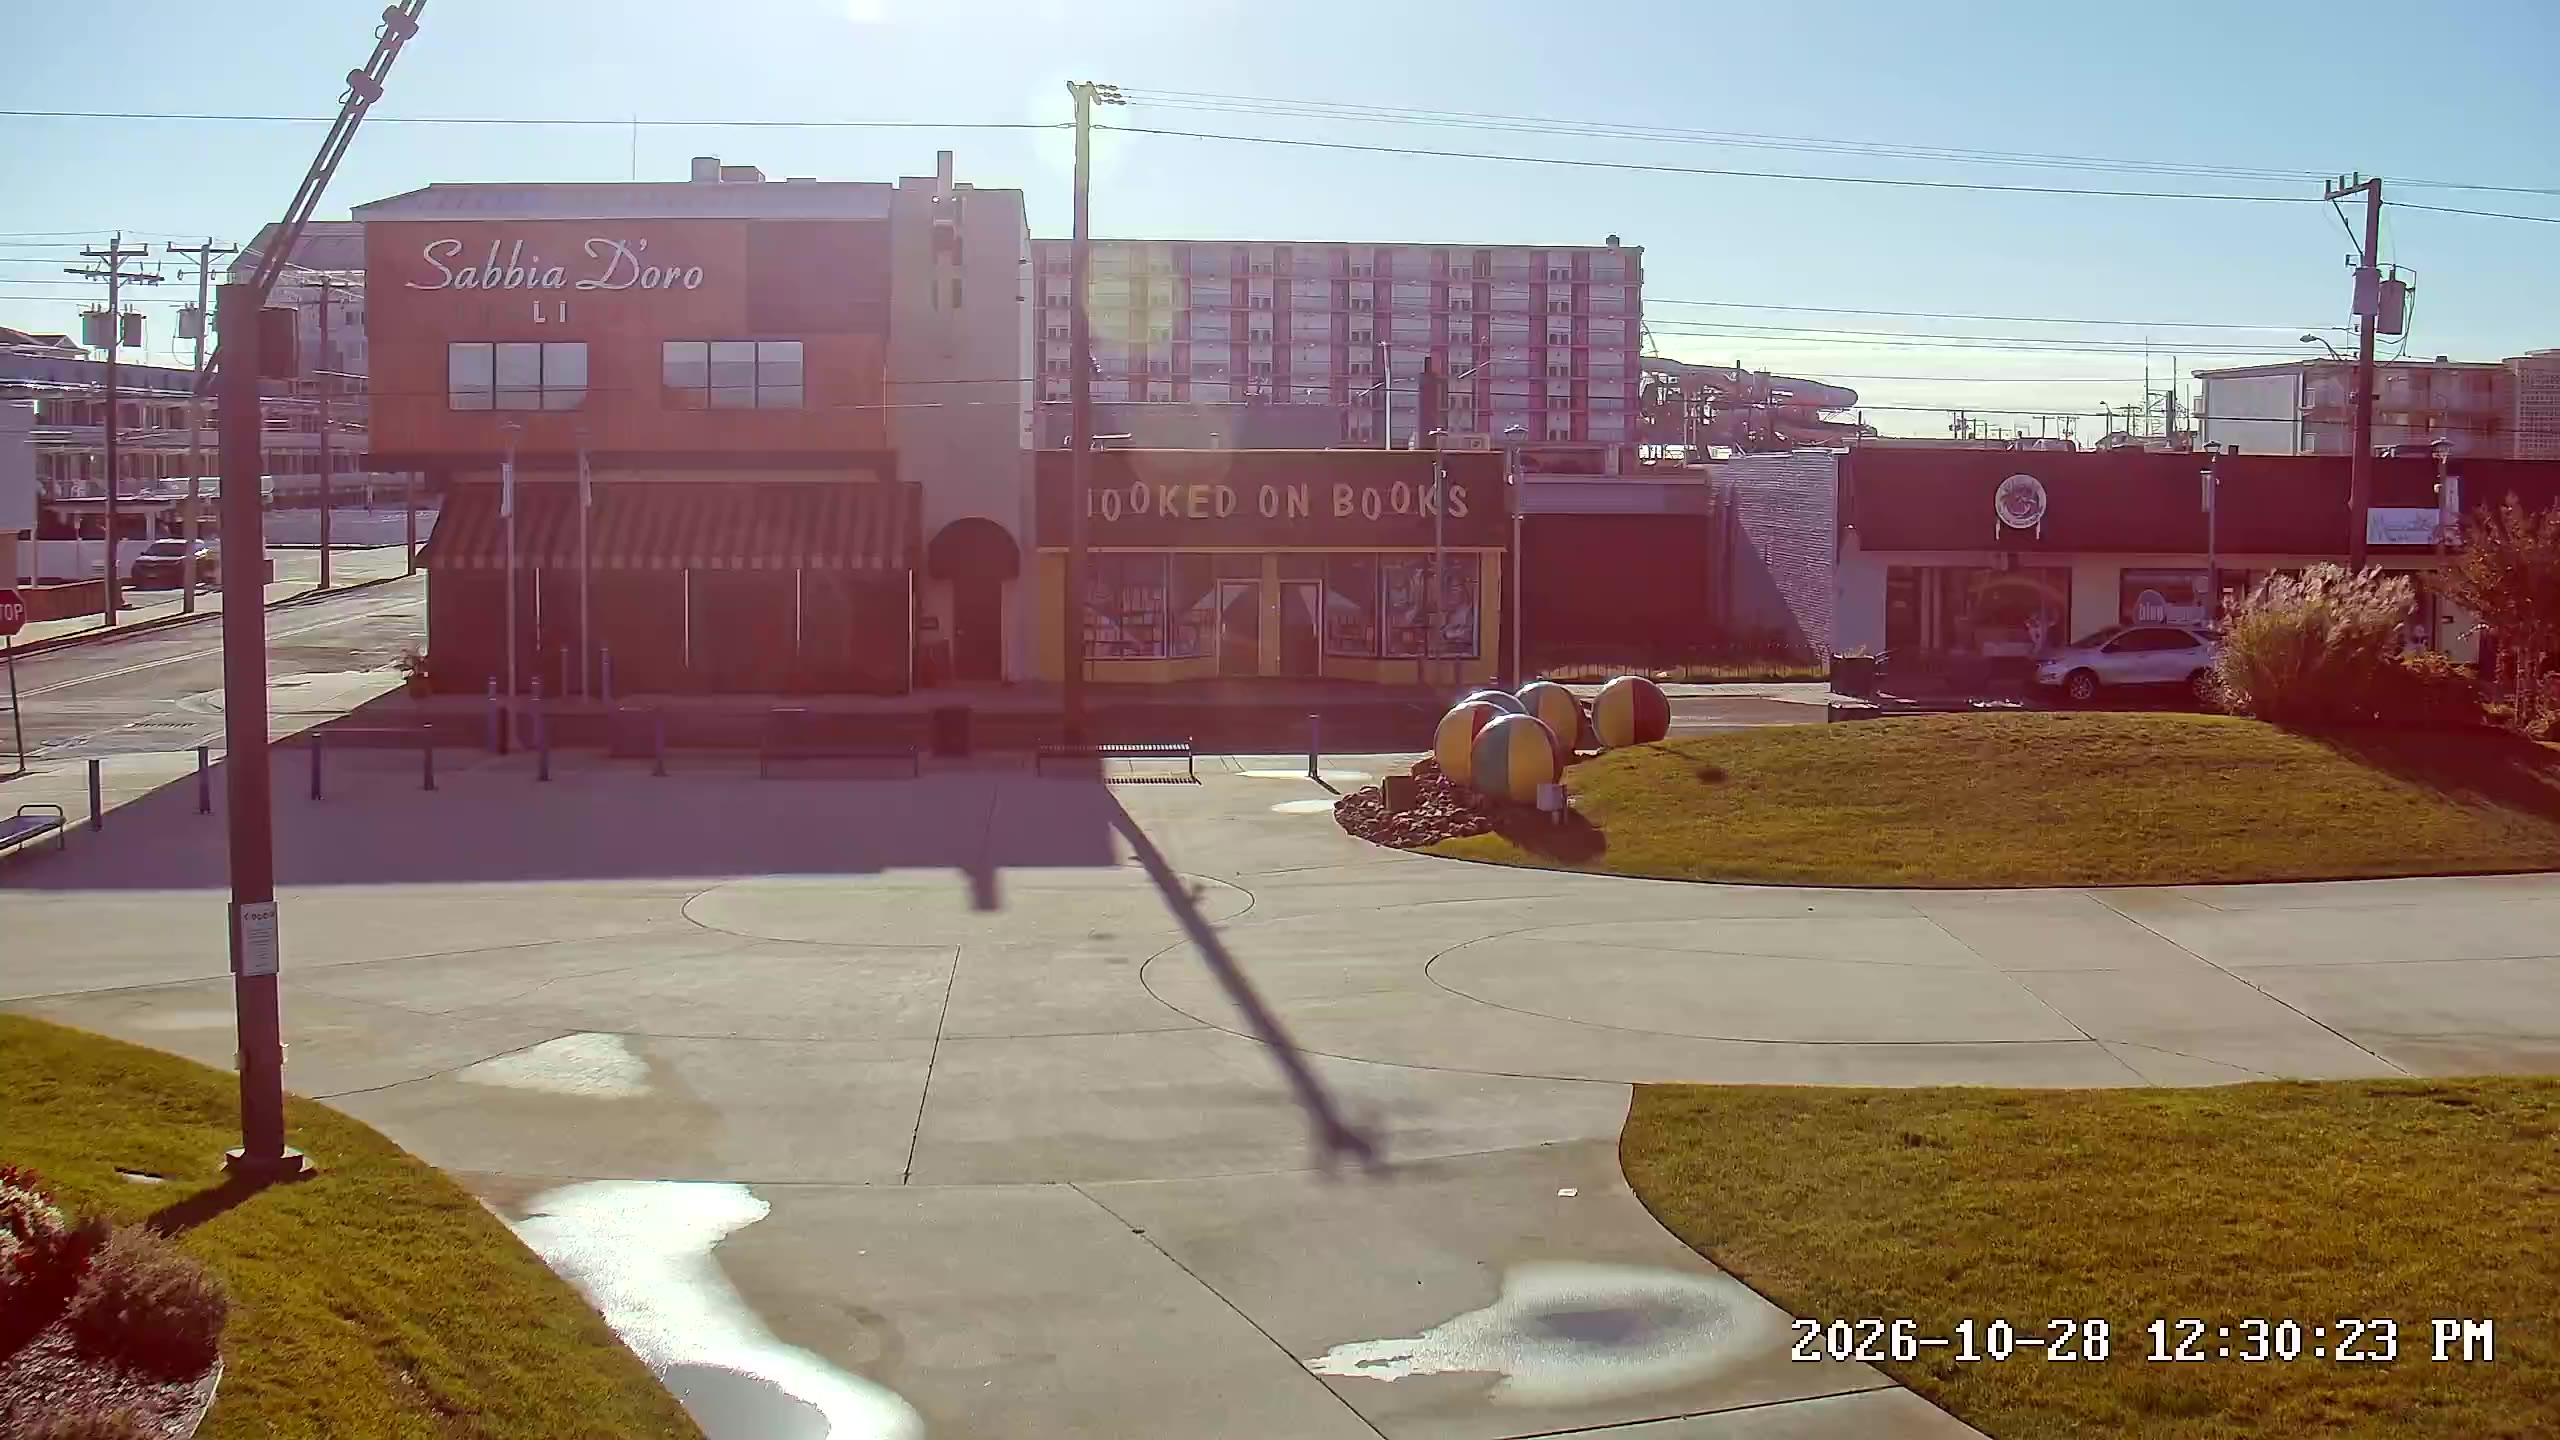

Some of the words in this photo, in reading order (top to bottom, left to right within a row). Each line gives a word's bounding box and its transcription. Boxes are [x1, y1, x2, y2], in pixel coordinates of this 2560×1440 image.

[404, 238, 567, 290] Sabbia
[576, 238, 704, 290] D'oro
[1257, 484, 1310, 518] ON
[1332, 480, 1470, 521] BOOKS
